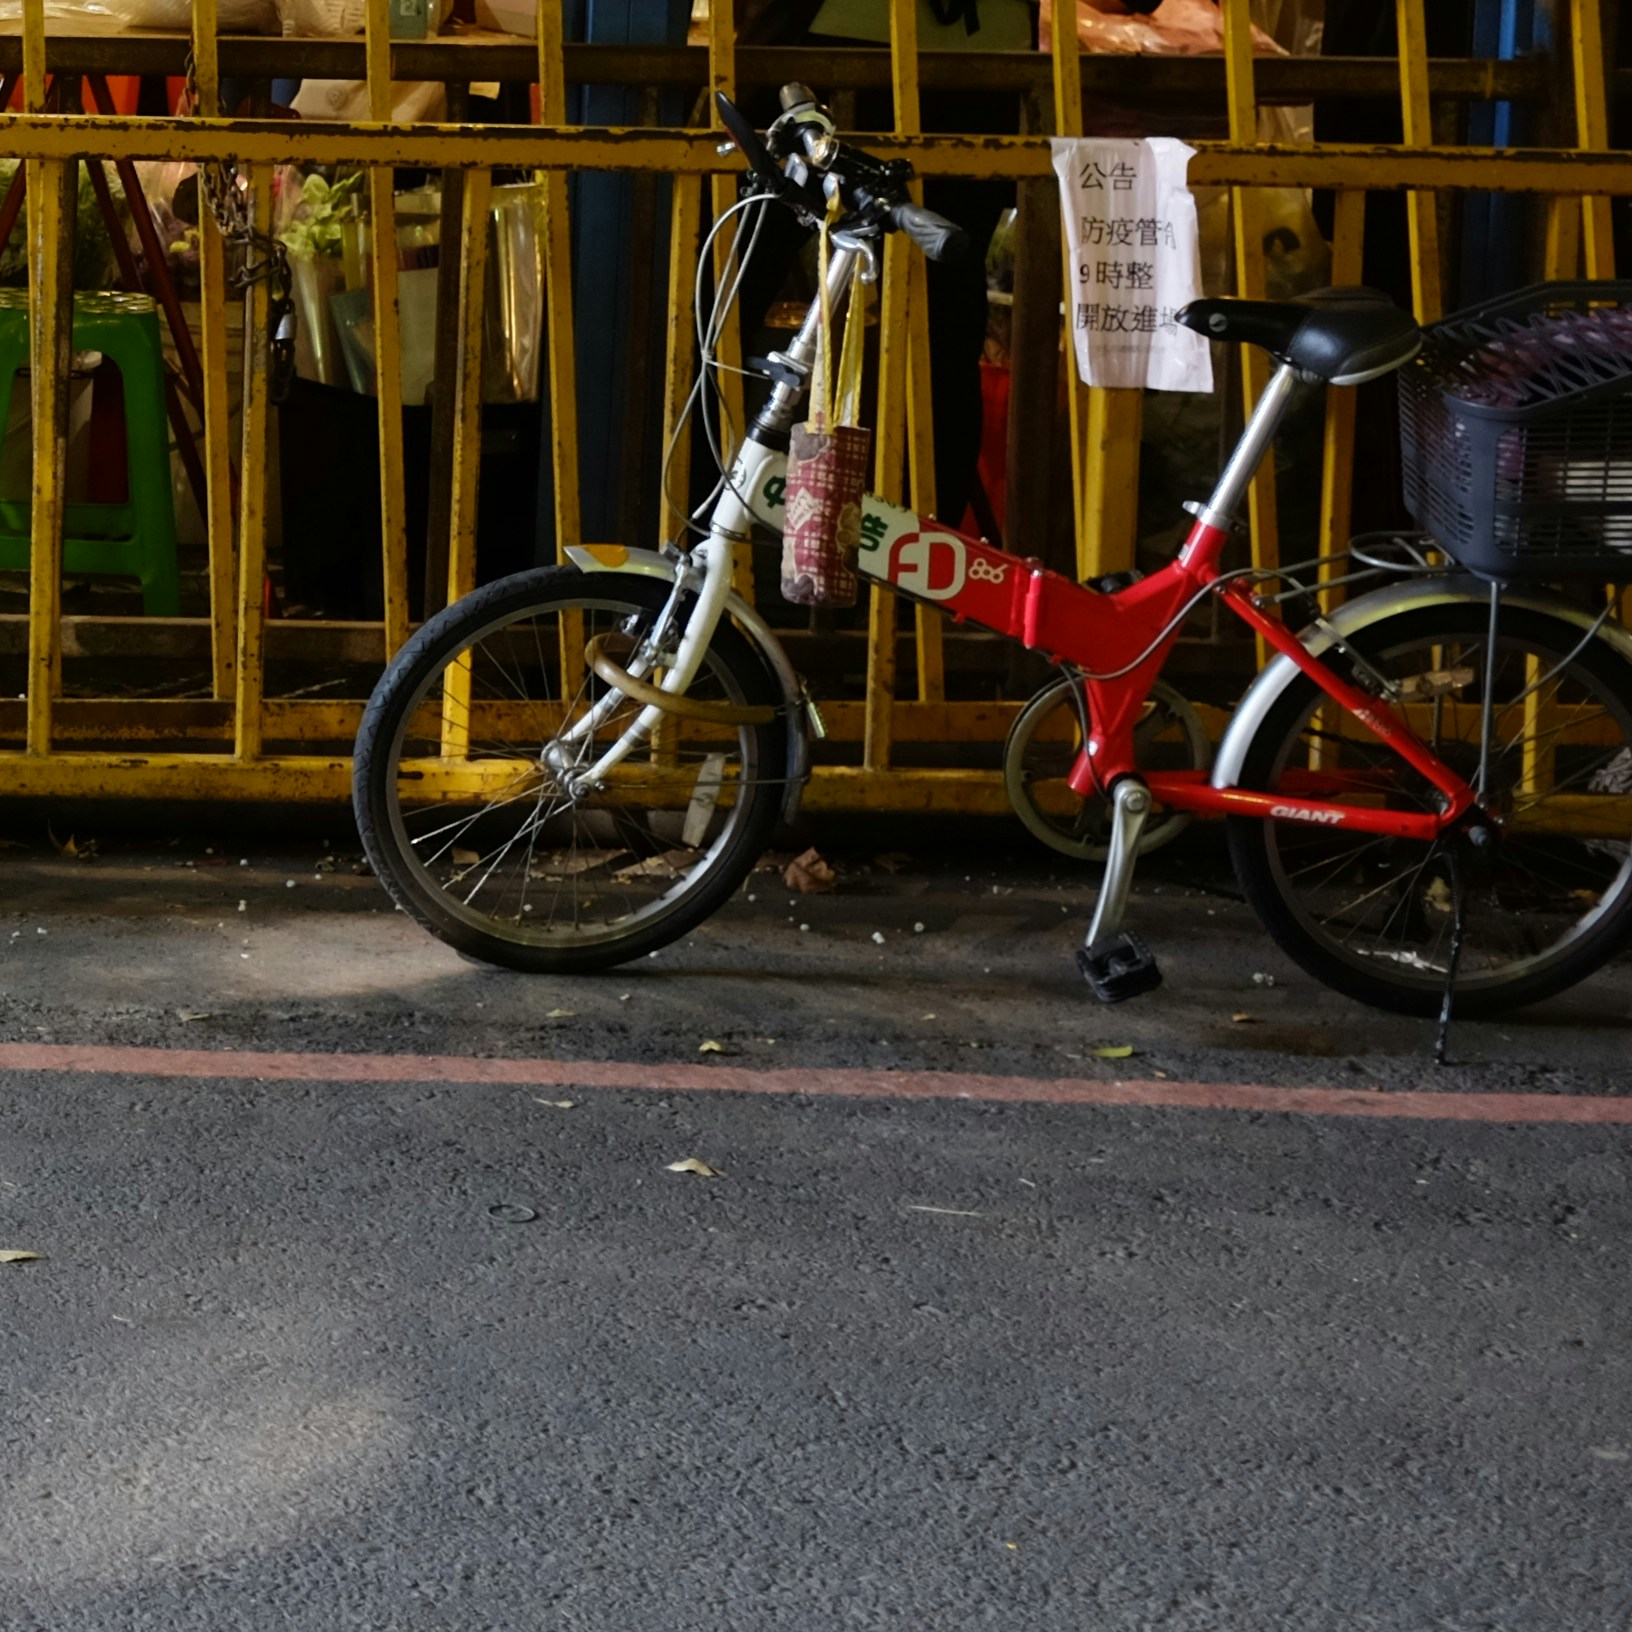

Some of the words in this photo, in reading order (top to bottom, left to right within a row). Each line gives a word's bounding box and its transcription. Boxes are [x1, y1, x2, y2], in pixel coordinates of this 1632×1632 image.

[1079, 162, 1137, 192] 公告
[1079, 261, 1154, 290] 9時整
[1270, 805, 1346, 825] GIANT
